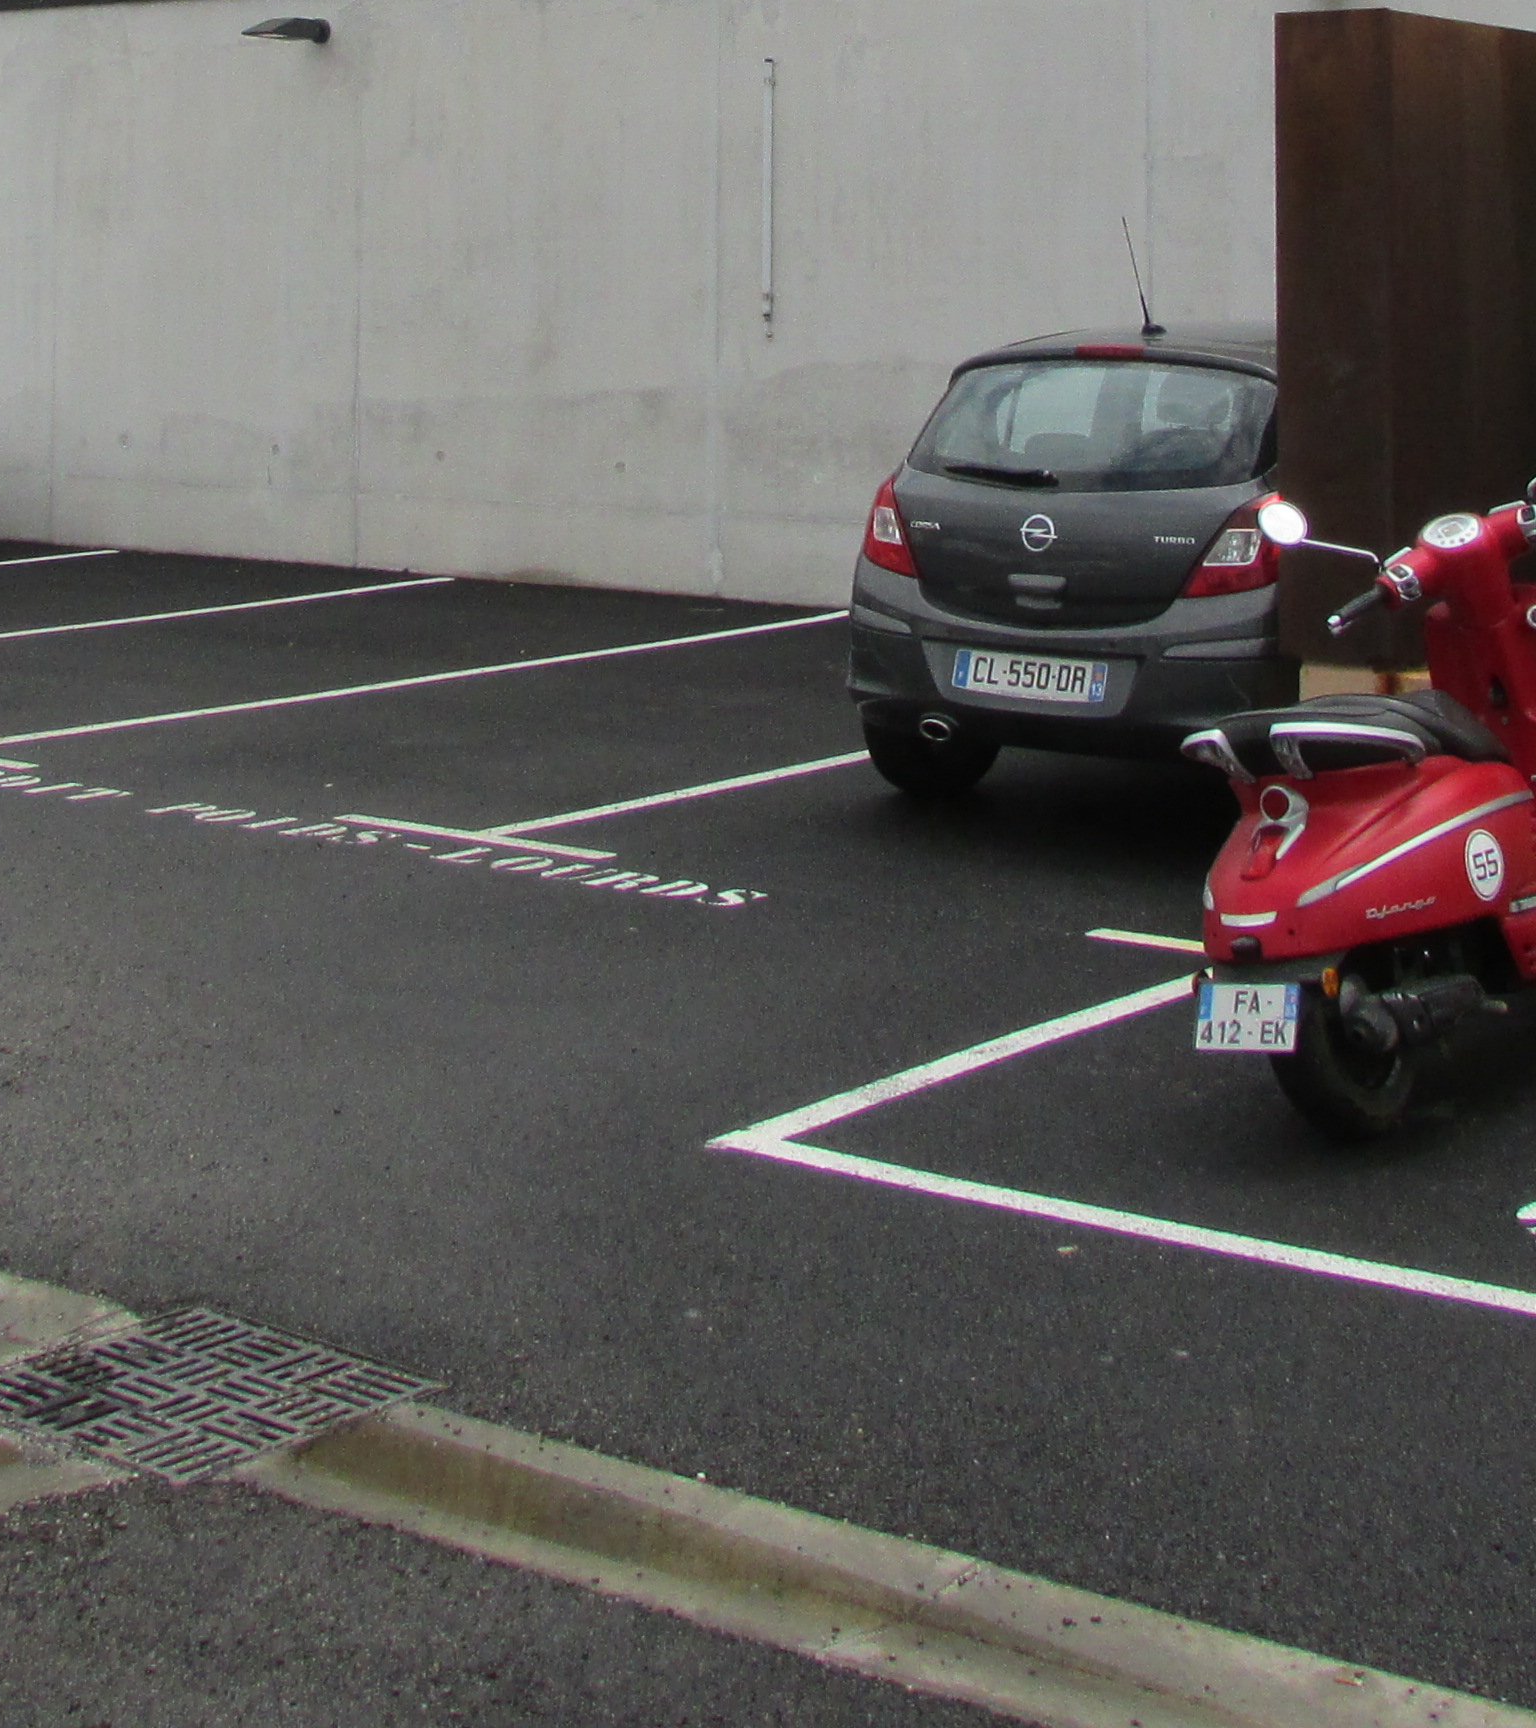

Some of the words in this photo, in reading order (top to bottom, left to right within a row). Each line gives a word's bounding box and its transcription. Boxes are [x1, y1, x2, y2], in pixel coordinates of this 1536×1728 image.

[1153, 535, 1195, 545] TURBO
[1091, 682, 1103, 697] 13
[1472, 848, 1499, 880] 55
